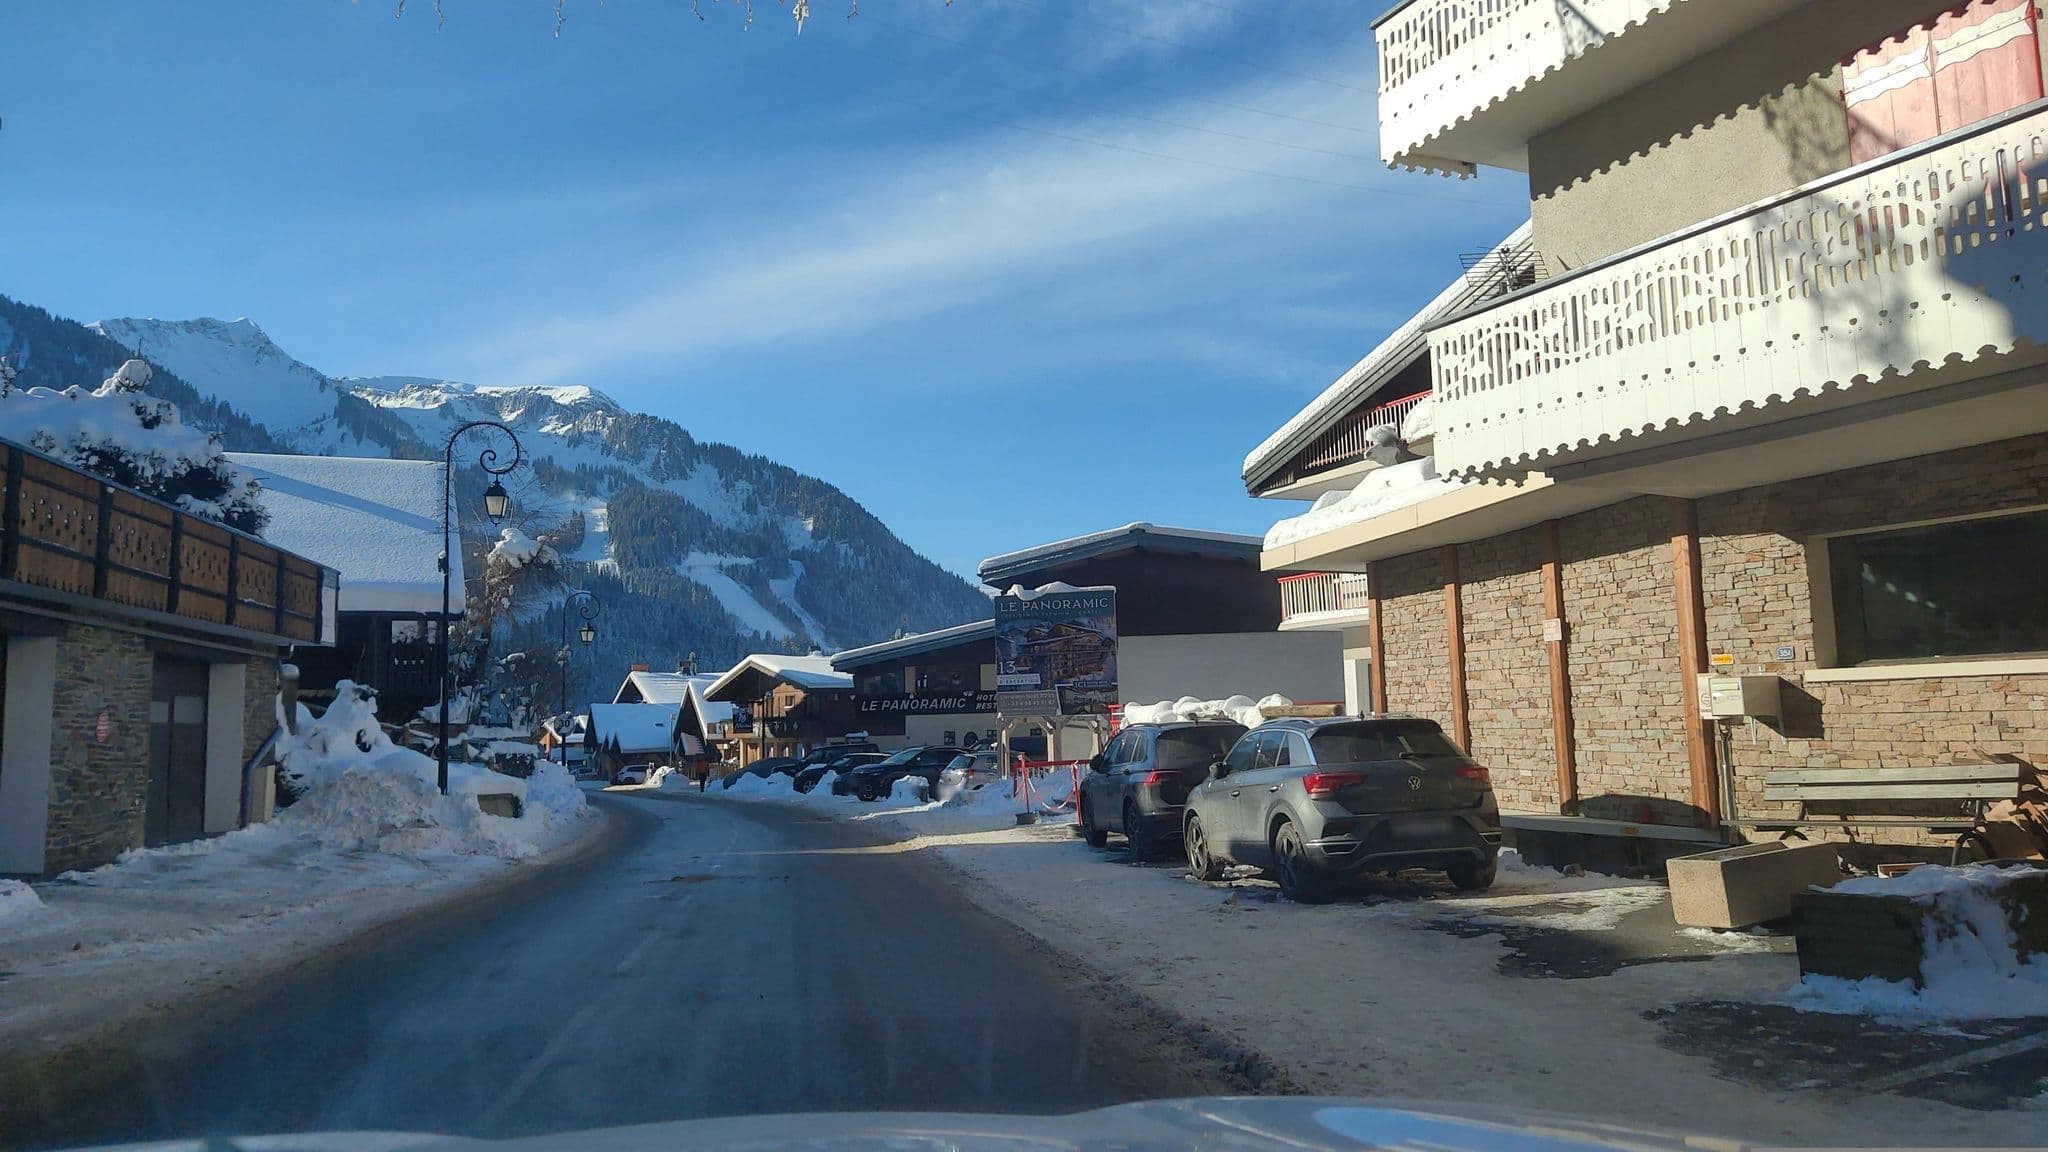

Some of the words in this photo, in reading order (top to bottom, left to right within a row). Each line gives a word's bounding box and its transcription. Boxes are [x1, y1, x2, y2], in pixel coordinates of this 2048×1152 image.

[1000, 602, 1018, 612] LE
[1022, 597, 1109, 611] PANORAMIC
[1000, 661, 1016, 674] 13
[861, 700, 878, 711] LE
[881, 698, 967, 711] PANORAMIC
[558, 719, 570, 728] 30
